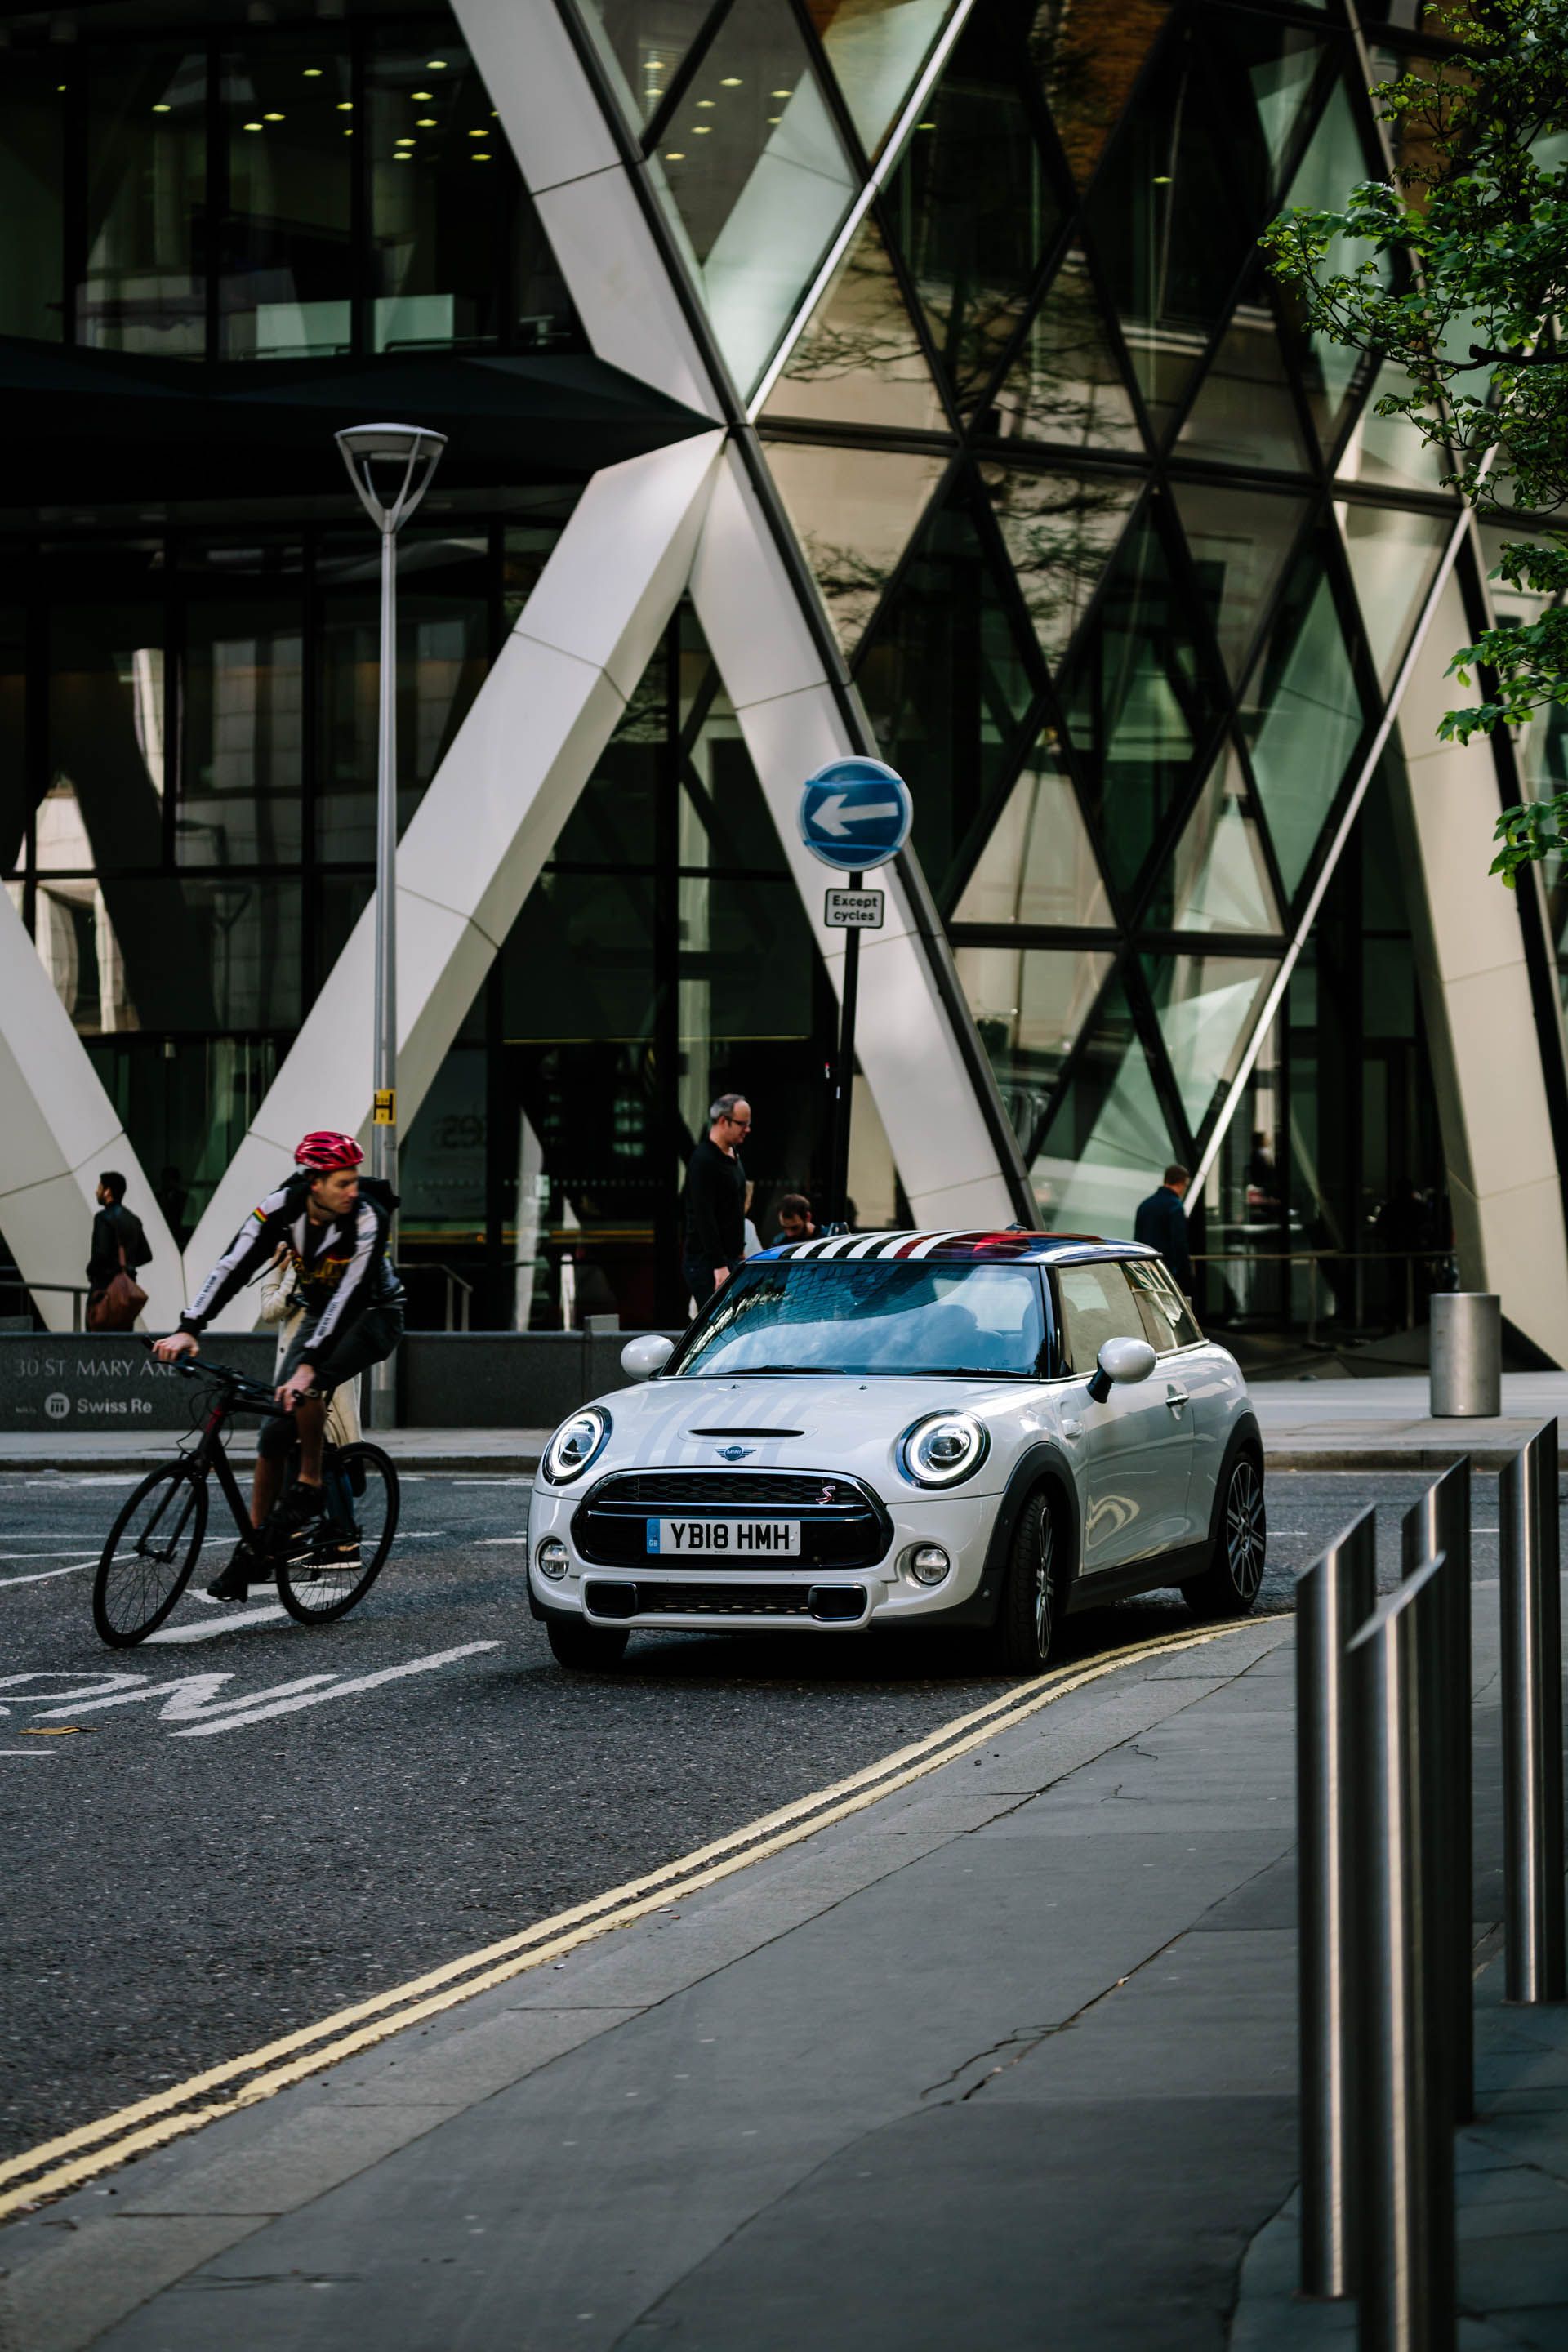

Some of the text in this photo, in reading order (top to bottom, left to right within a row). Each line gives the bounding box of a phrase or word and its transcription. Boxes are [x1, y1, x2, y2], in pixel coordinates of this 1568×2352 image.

[833, 895, 878, 908] Except
[834, 910, 875, 922] cycles
[373, 1093, 393, 1121] H
[16, 1358, 38, 1377] 30
[44, 1358, 65, 1377] ST
[77, 1358, 133, 1377] MARY
[78, 1397, 153, 1414] Swiss Re
[815, 1485, 836, 1503] S
[648, 1539, 658, 1547] GB
[670, 1523, 790, 1550] YB18 HMH
